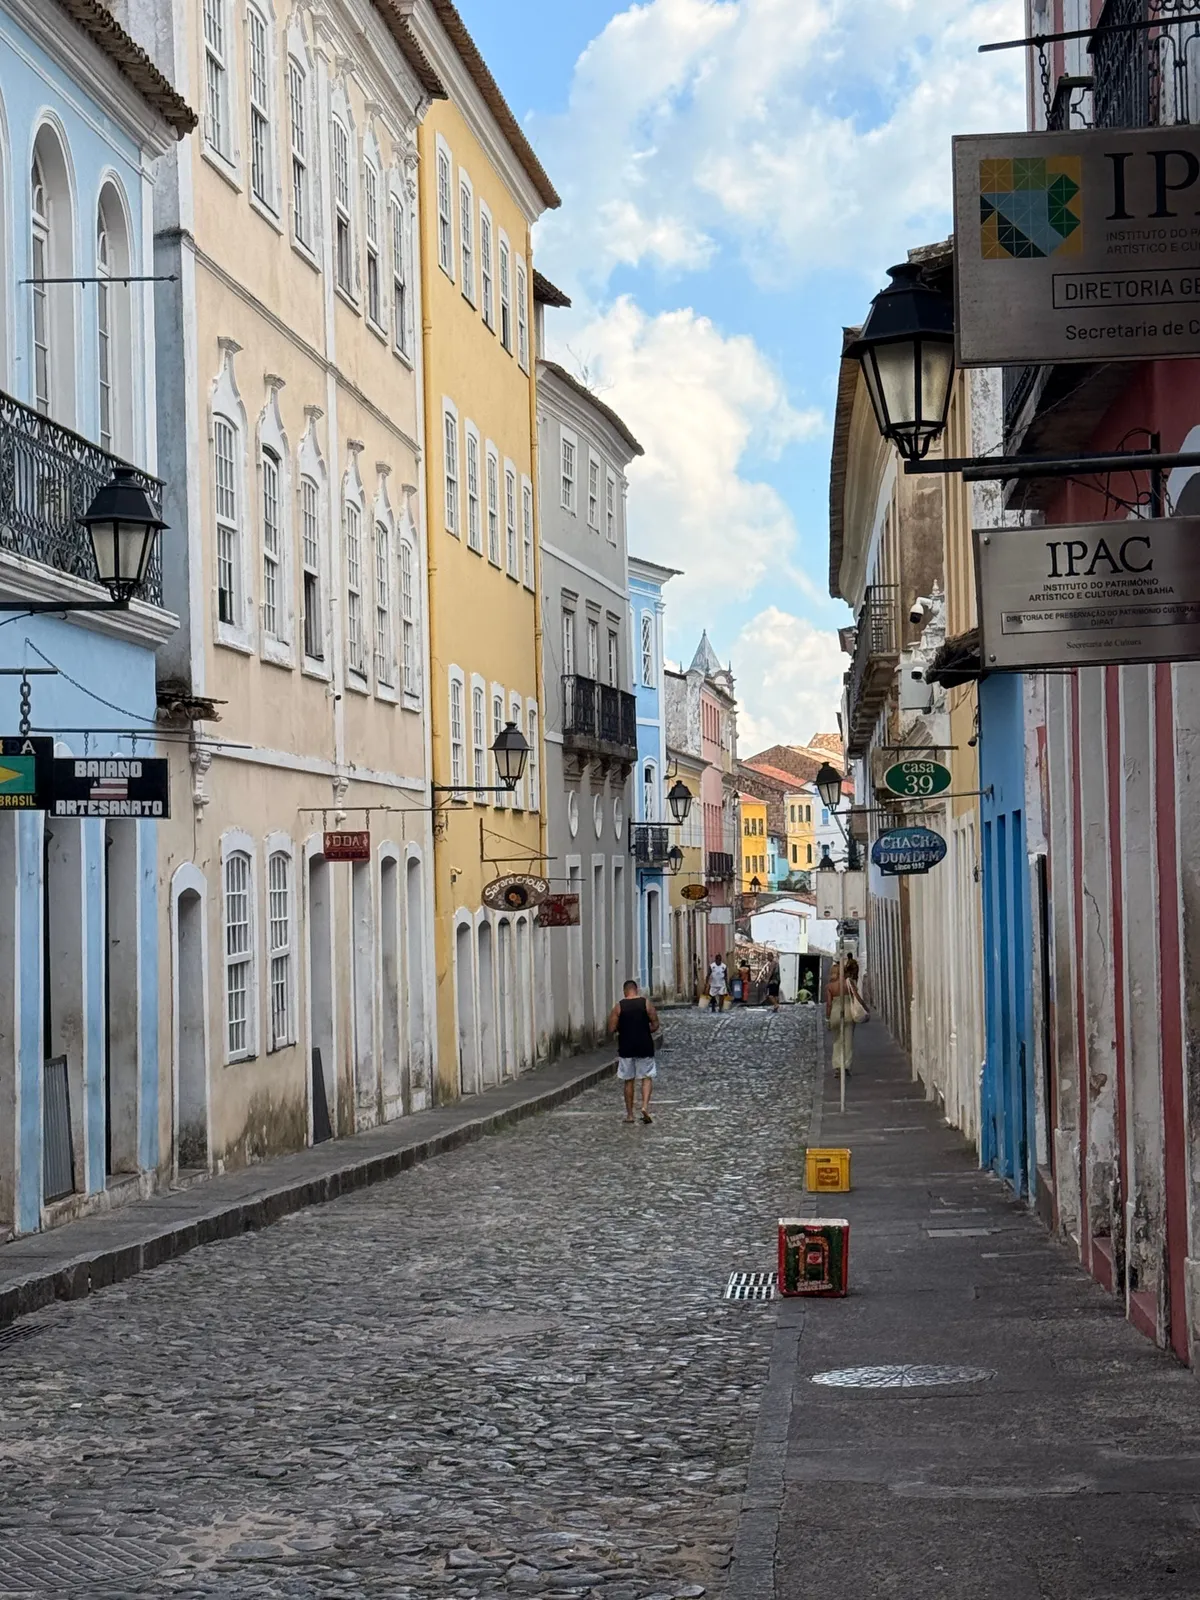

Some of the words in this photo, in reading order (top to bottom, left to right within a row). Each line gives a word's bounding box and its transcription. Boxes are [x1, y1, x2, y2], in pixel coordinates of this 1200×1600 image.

[1104, 150, 1200, 221] IP
[1106, 229, 1167, 241] INSTITUTO
[1170, 228, 1188, 239] DO
[1170, 242, 1179, 252] E
[1181, 240, 1200, 252] CU
[1065, 278, 1174, 301] DIRETORIA
[1065, 322, 1158, 340] Secretaria
[1162, 319, 1184, 336] de
[1046, 535, 1153, 578] IPAC
[1043, 582, 1088, 592] INSTITUTO
[1090, 580, 1104, 590] DO
[1105, 577, 1159, 588] PATRIMÔNIO
[1028, 592, 1075, 602] ARTÍSTICO
[1076, 591, 1083, 600] E
[1084, 588, 1130, 599] CULTURAL
[1132, 588, 1146, 596] DA
[1148, 586, 1174, 595] BAHIA
[74, 760, 143, 778] BAIANO
[902, 761, 935, 774] casa
[904, 774, 934, 796] 39
[0, 794, 37, 807] BRASIL
[55, 800, 163, 816] ARTESANATO
